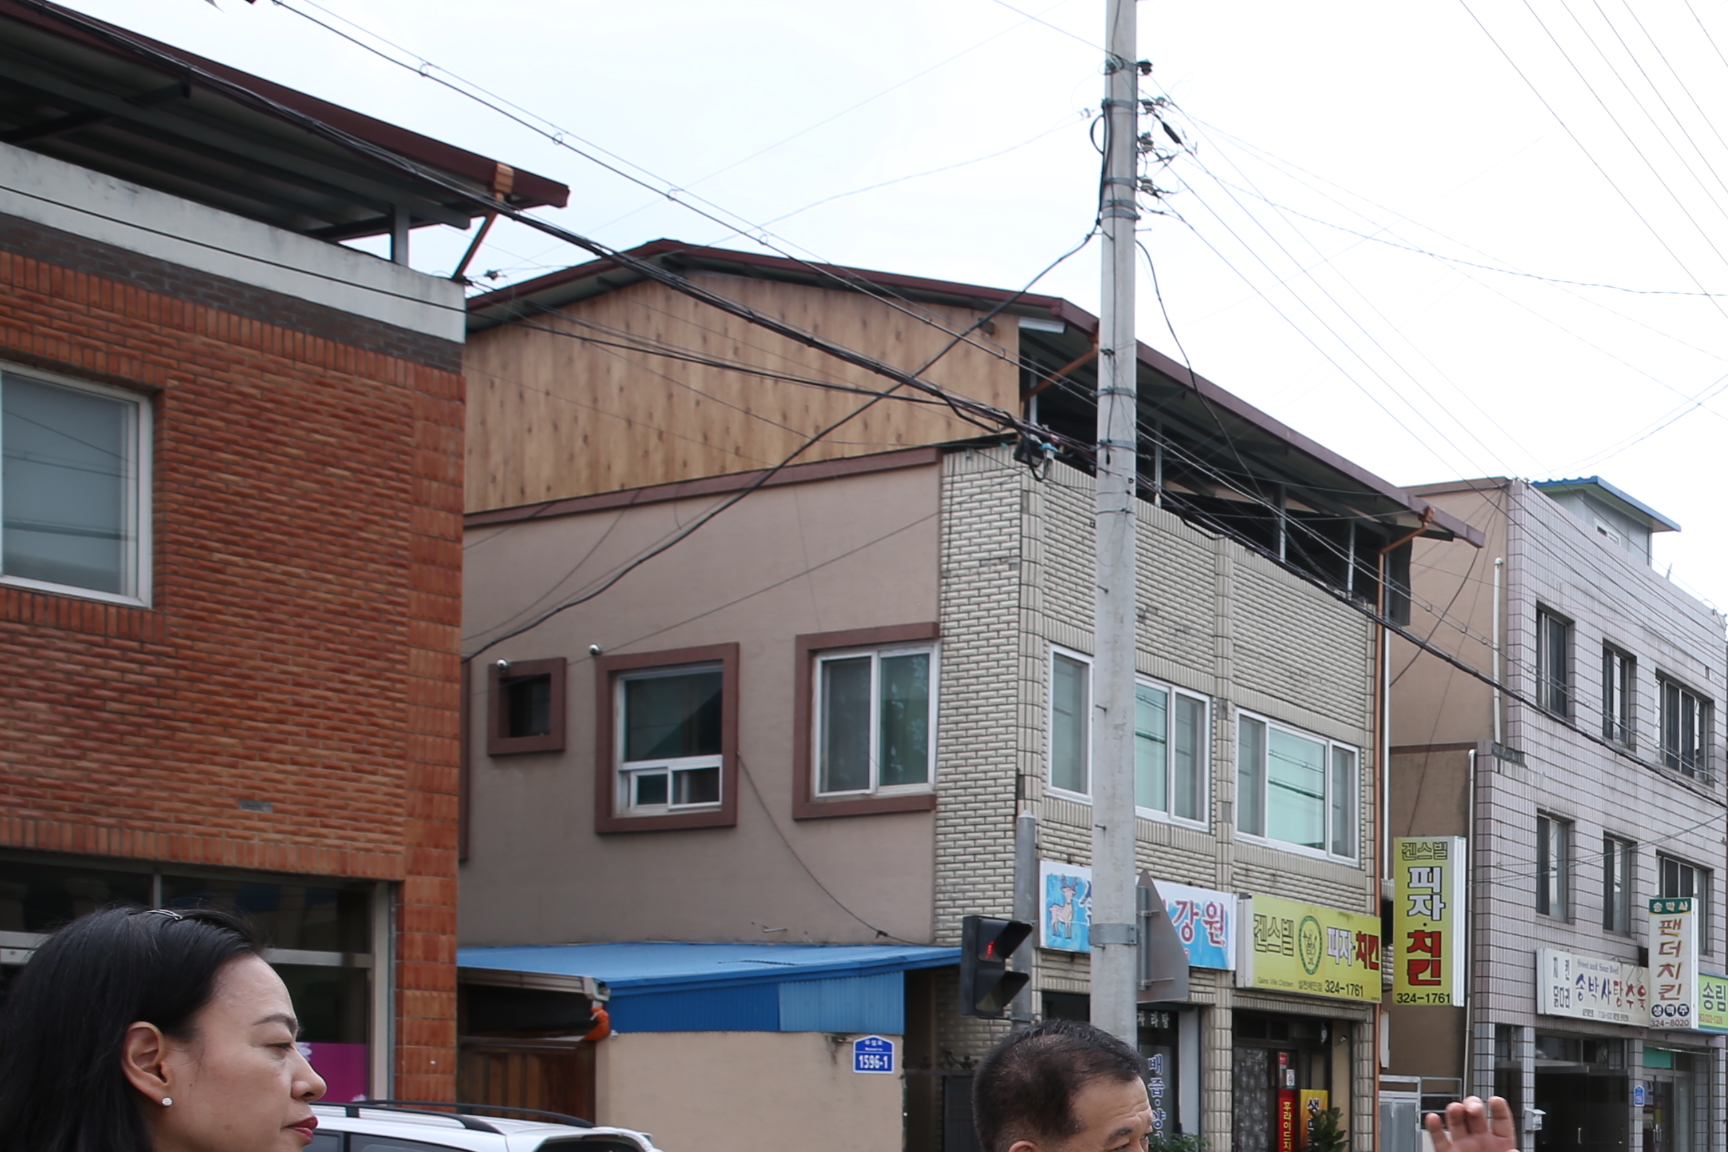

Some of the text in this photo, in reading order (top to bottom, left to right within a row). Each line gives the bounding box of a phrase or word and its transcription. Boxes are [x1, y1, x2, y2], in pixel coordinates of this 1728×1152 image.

[1401, 842, 1448, 861] 겐스빌
[1162, 899, 1226, 946] 강원
[1253, 913, 1294, 957] 겐스빌
[1657, 918, 1682, 1001] 팬더치킨
[1324, 980, 1364, 998] 324-1761
[1397, 992, 1450, 1004] 324-1761
[1702, 981, 1727, 1013] 송림
[1651, 1003, 1689, 1017] 생맥주
[1650, 1019, 1689, 1028] 324-8020
